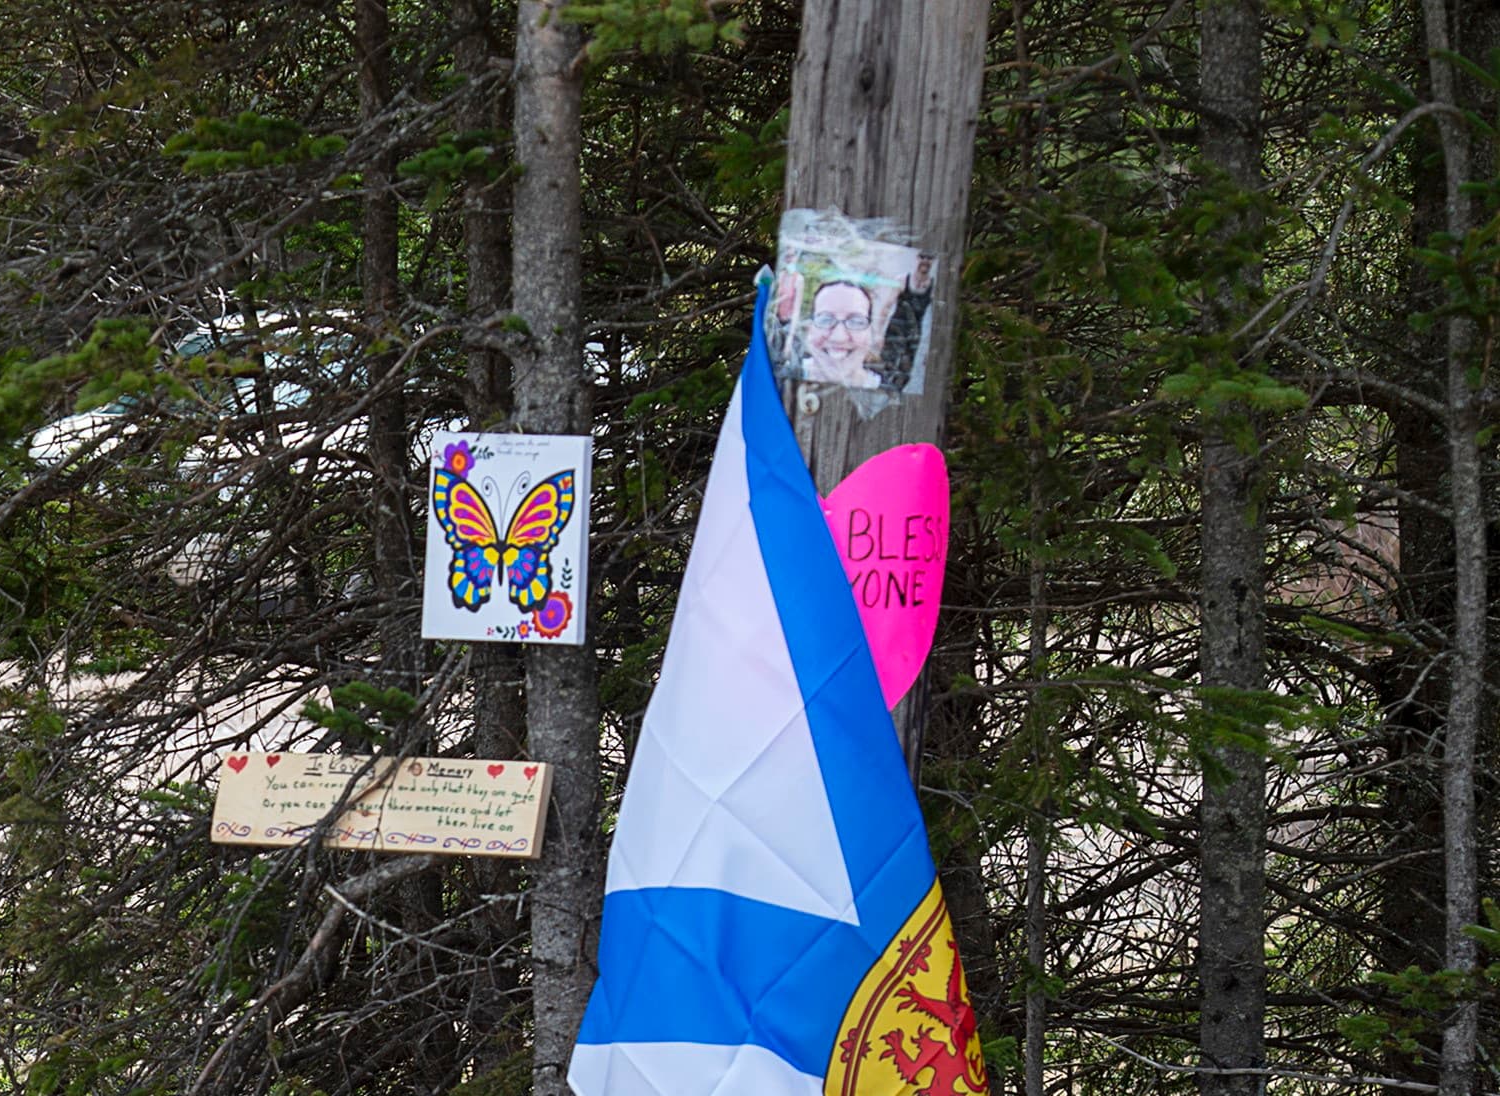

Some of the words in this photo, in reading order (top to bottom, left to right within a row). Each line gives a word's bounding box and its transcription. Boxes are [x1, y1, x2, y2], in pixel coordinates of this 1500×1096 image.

[796, 383, 820, 416] 6
[427, 762, 473, 778] Memory
[266, 775, 287, 790] You
[442, 781, 464, 794] that
[467, 784, 488, 801] they
[281, 802, 301, 812] you
[305, 801, 326, 809] can
[416, 805, 466, 814] memories
[473, 816, 494, 831] live
[499, 823, 514, 832] on
